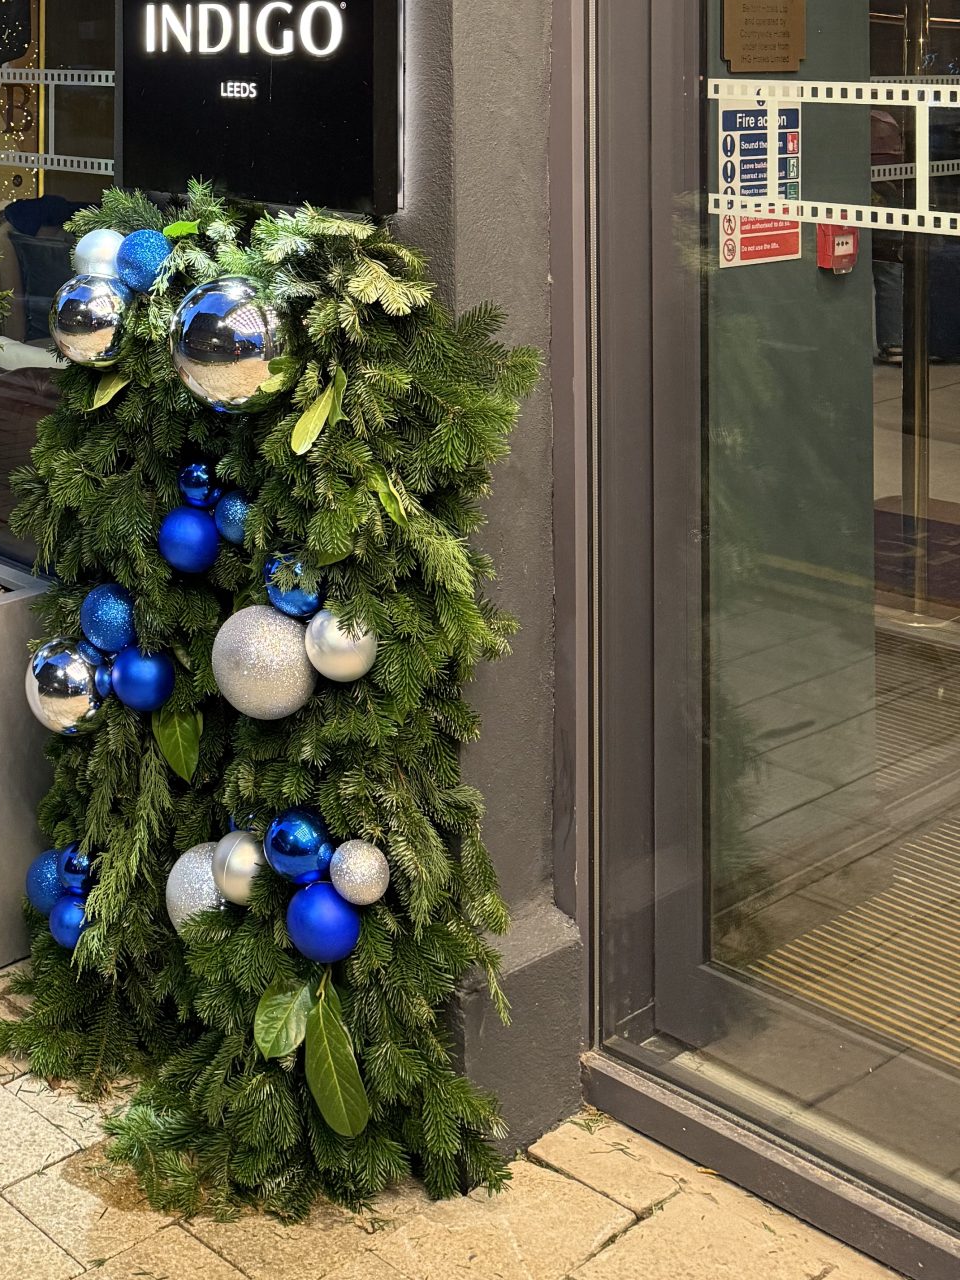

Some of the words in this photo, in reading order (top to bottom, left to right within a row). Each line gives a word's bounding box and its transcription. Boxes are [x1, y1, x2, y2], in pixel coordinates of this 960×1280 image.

[220, 81, 257, 98] LEEDS
[736, 113, 755, 128] Fire
[741, 141, 759, 149] Sound
